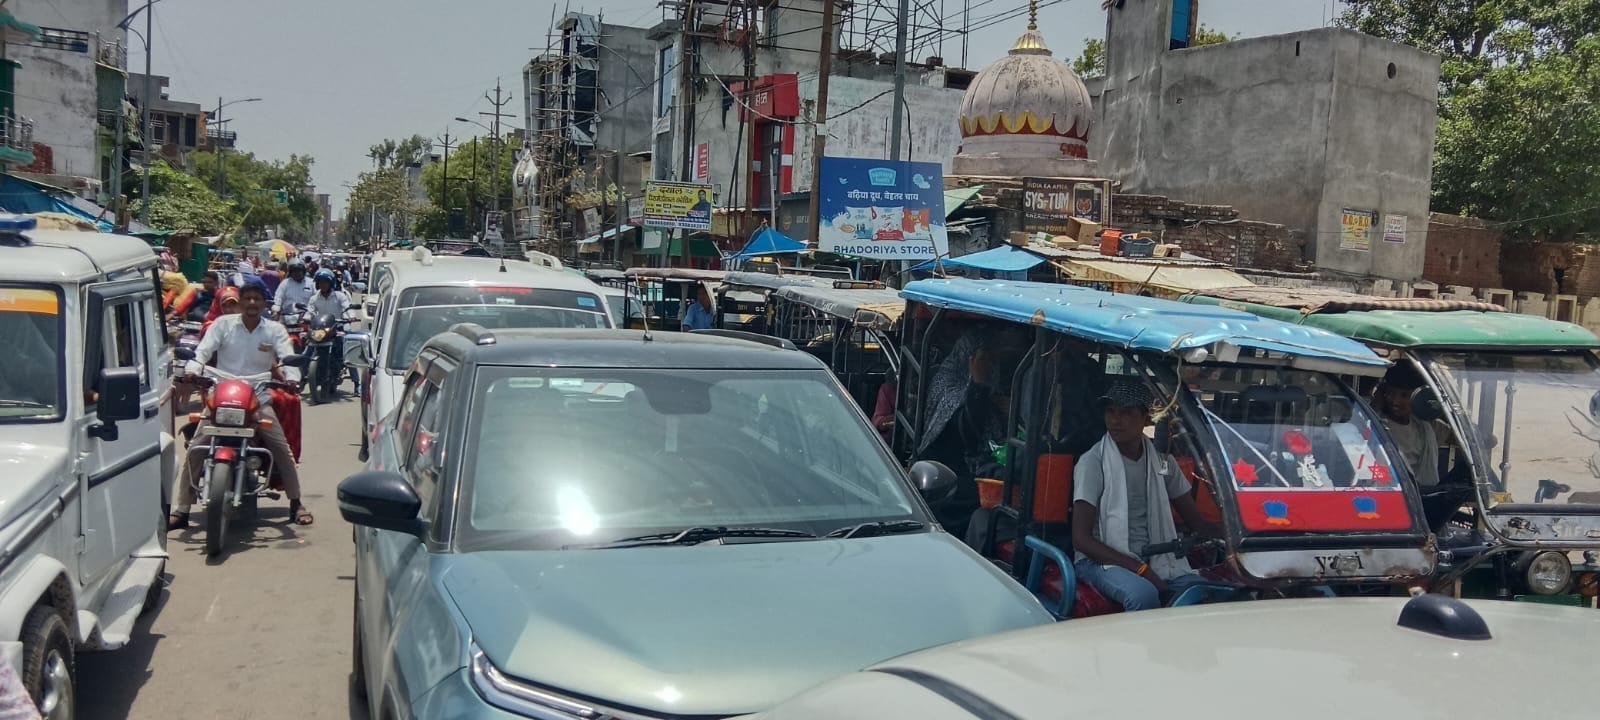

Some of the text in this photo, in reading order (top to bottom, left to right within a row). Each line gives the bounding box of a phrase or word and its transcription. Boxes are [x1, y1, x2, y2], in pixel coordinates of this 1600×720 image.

[884, 190, 903, 201] बेहतर
[1025, 190, 1070, 212] SYS-TUM
[834, 245, 935, 255] BHADORIYA STORE
